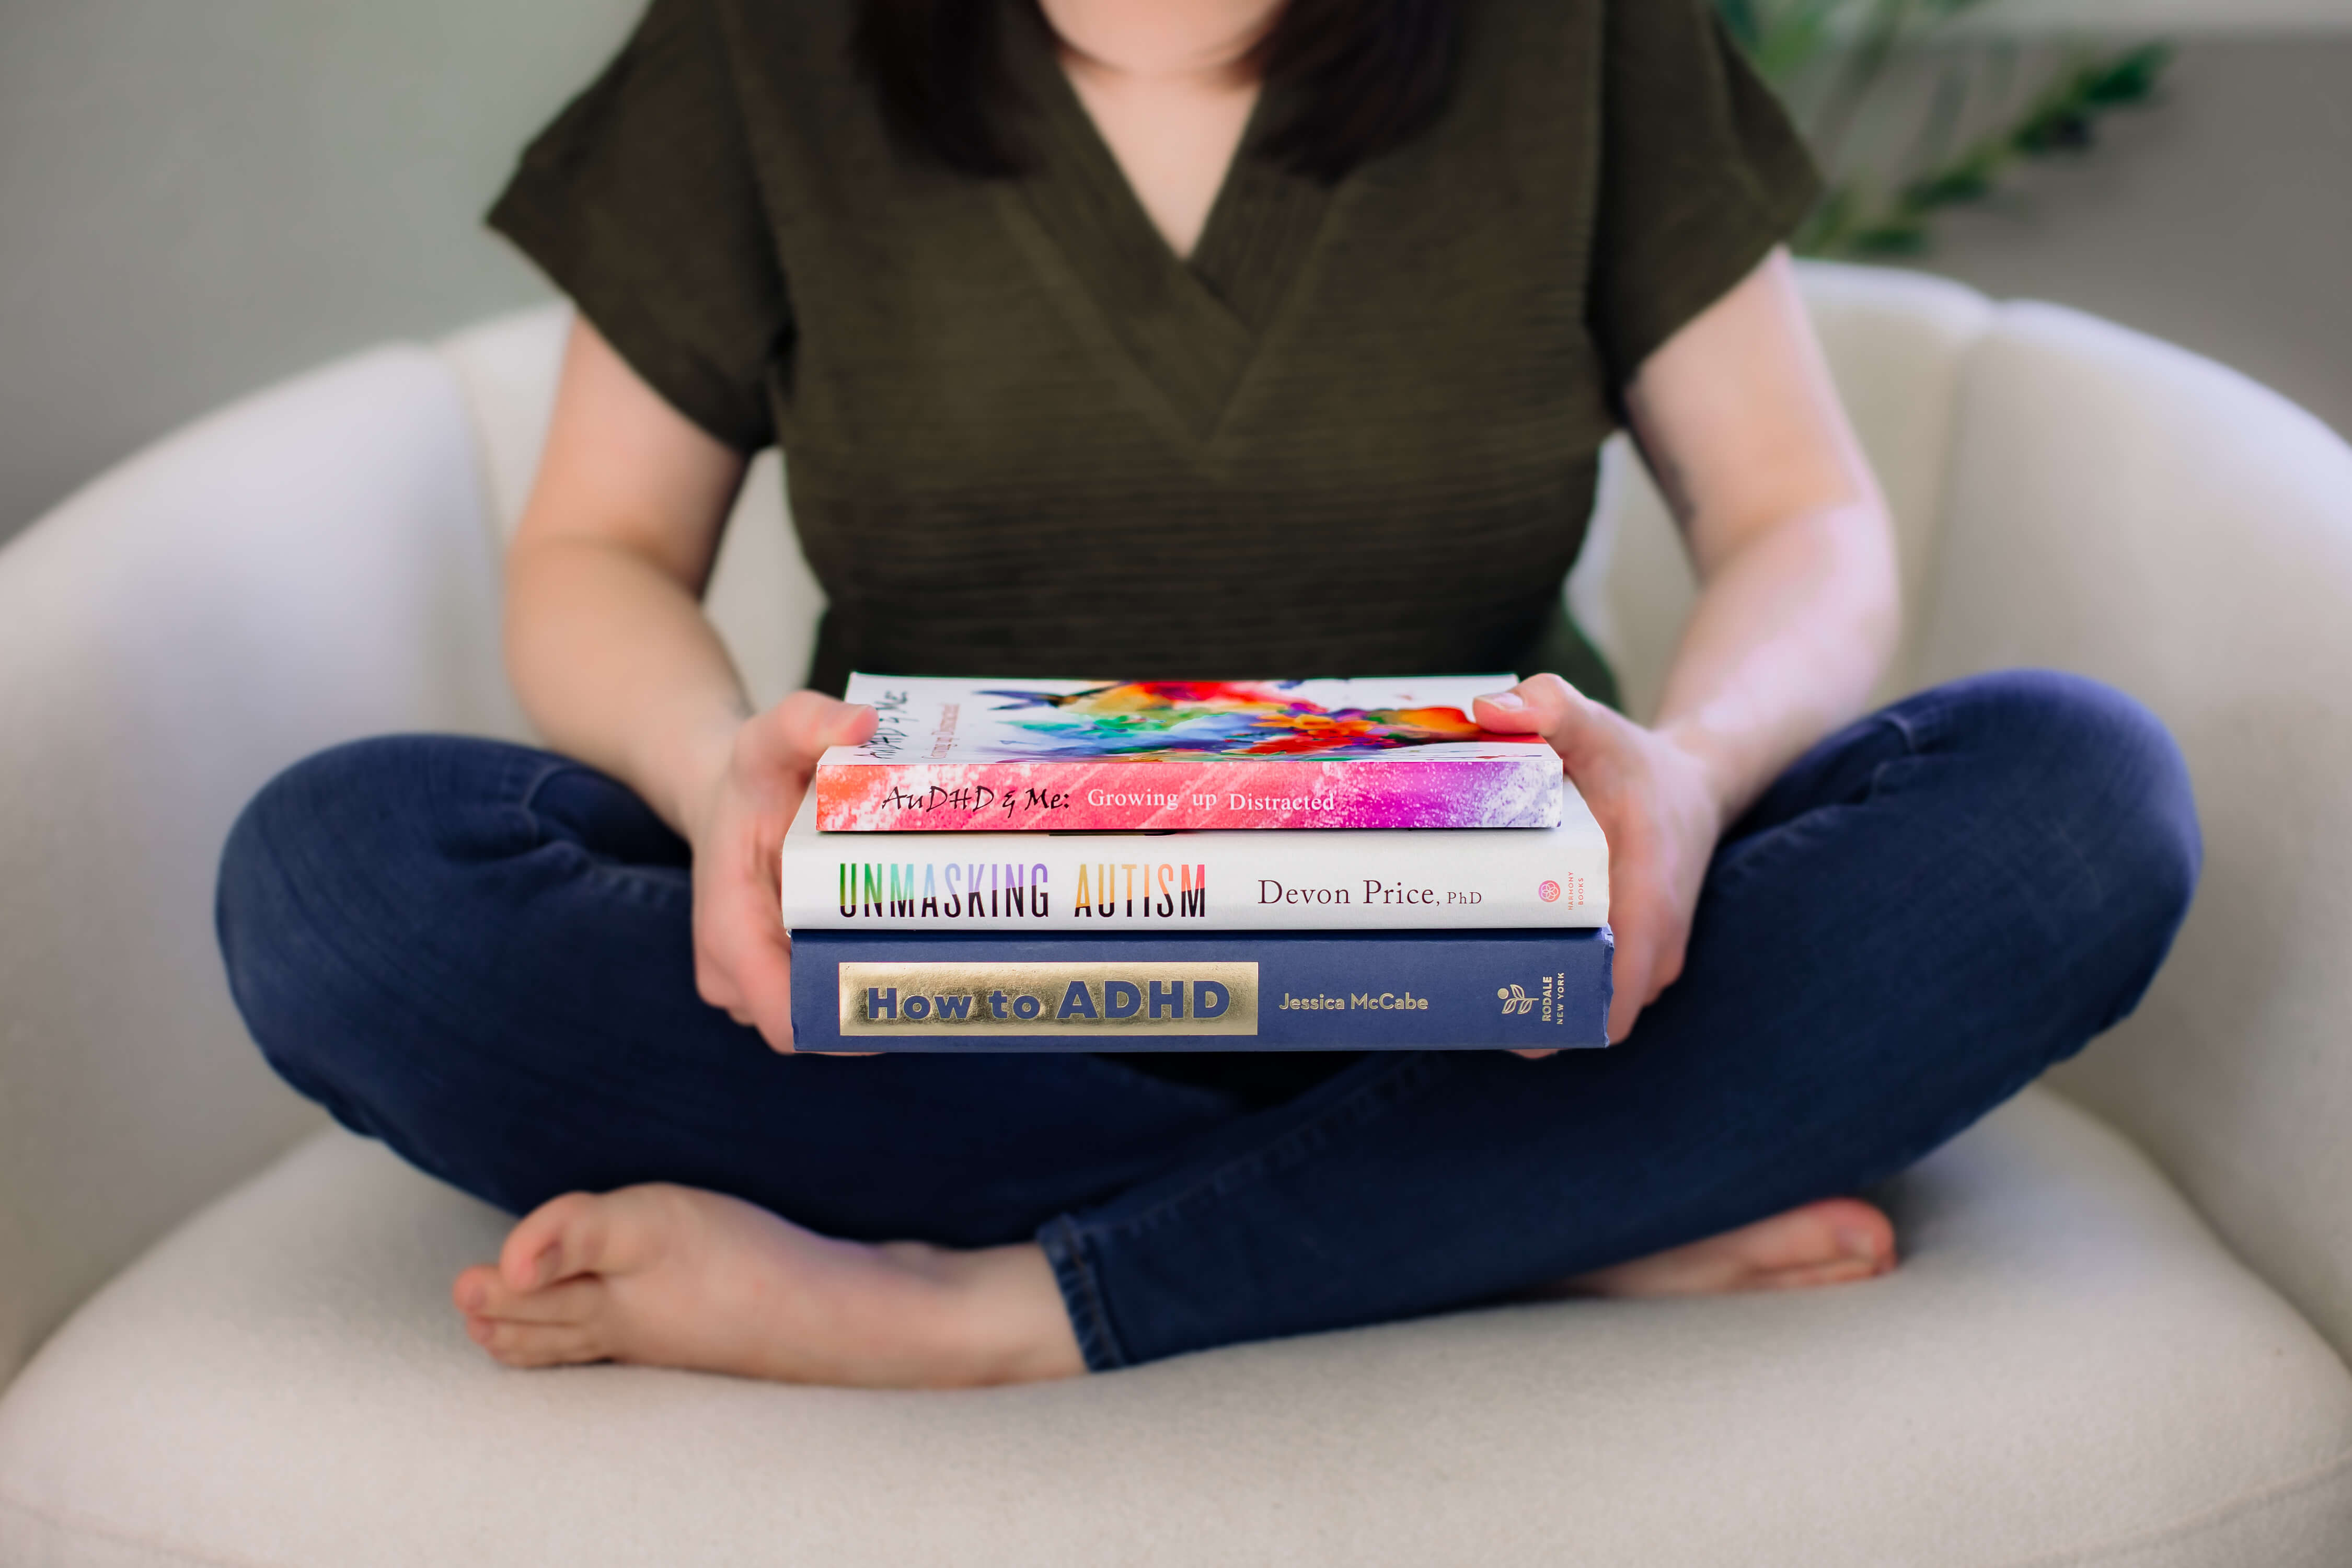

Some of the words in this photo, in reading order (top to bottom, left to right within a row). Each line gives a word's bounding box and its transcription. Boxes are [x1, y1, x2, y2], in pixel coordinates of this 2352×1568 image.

[882, 786, 994, 812] AuDHD
[1002, 790, 1016, 818] &
[1025, 788, 1069, 811] Me:
[1088, 788, 1179, 811] Growing
[1193, 793, 1217, 811] up
[1230, 793, 1335, 811] Distracted
[840, 863, 1048, 918] UNMASKING
[1075, 863, 1205, 918] AUTISM
[1258, 880, 1351, 904] Devon
[1363, 880, 1440, 907] Price,
[1447, 891, 1482, 905] PhD
[867, 987, 970, 1019] How
[988, 989, 1041, 1019] to
[1055, 980, 1230, 1019] ADHD
[1278, 993, 1345, 1011] Jessica
[1351, 992, 1428, 1011] McCabe
[1542, 976, 1552, 1021] RODALE
